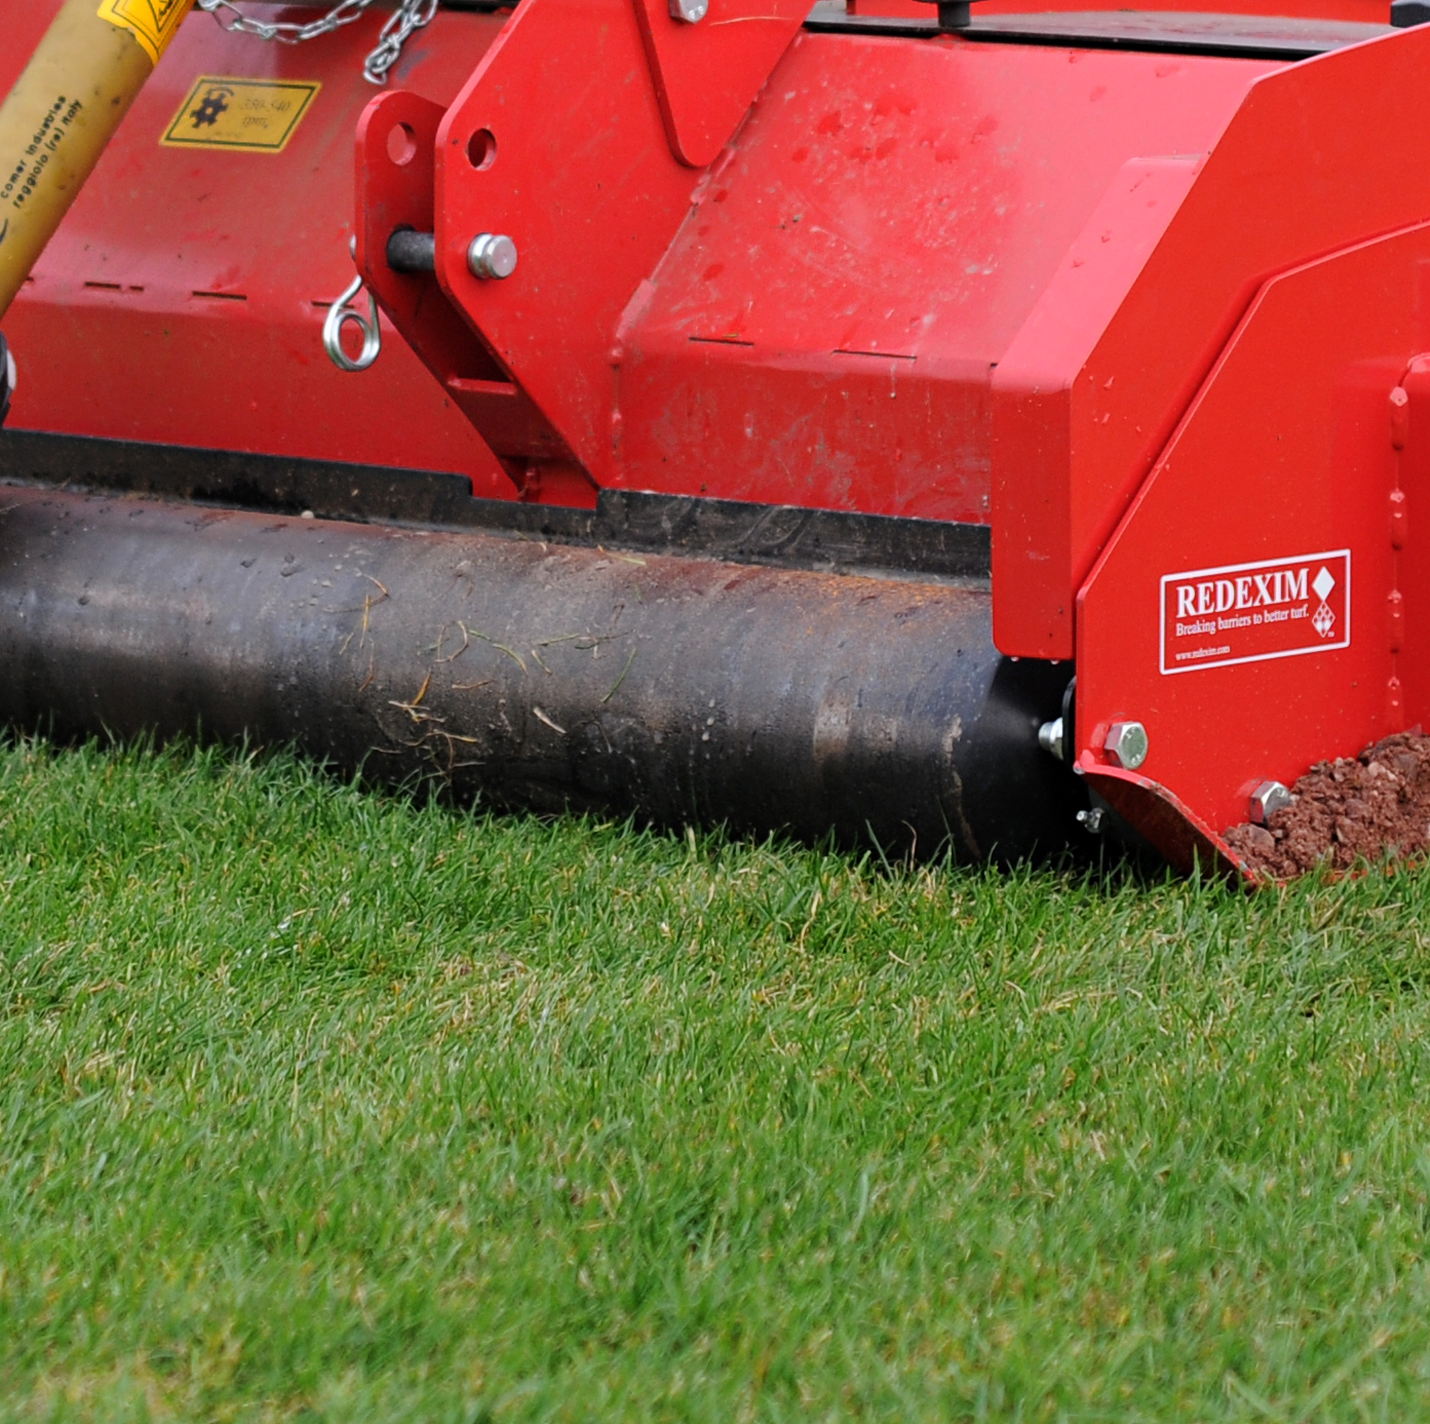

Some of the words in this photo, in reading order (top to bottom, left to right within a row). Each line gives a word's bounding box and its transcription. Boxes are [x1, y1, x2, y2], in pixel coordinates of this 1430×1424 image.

[0, 159, 26, 199] comer
[25, 95, 66, 156] industries
[12, 154, 48, 208] reggiolo
[1176, 567, 1310, 618] REDEXIM
[1175, 619, 1216, 637] Breaking
[1218, 614, 1252, 630] barriers
[1253, 613, 1263, 625] to
[1264, 608, 1289, 624] better
[1290, 604, 1310, 619] turf.
